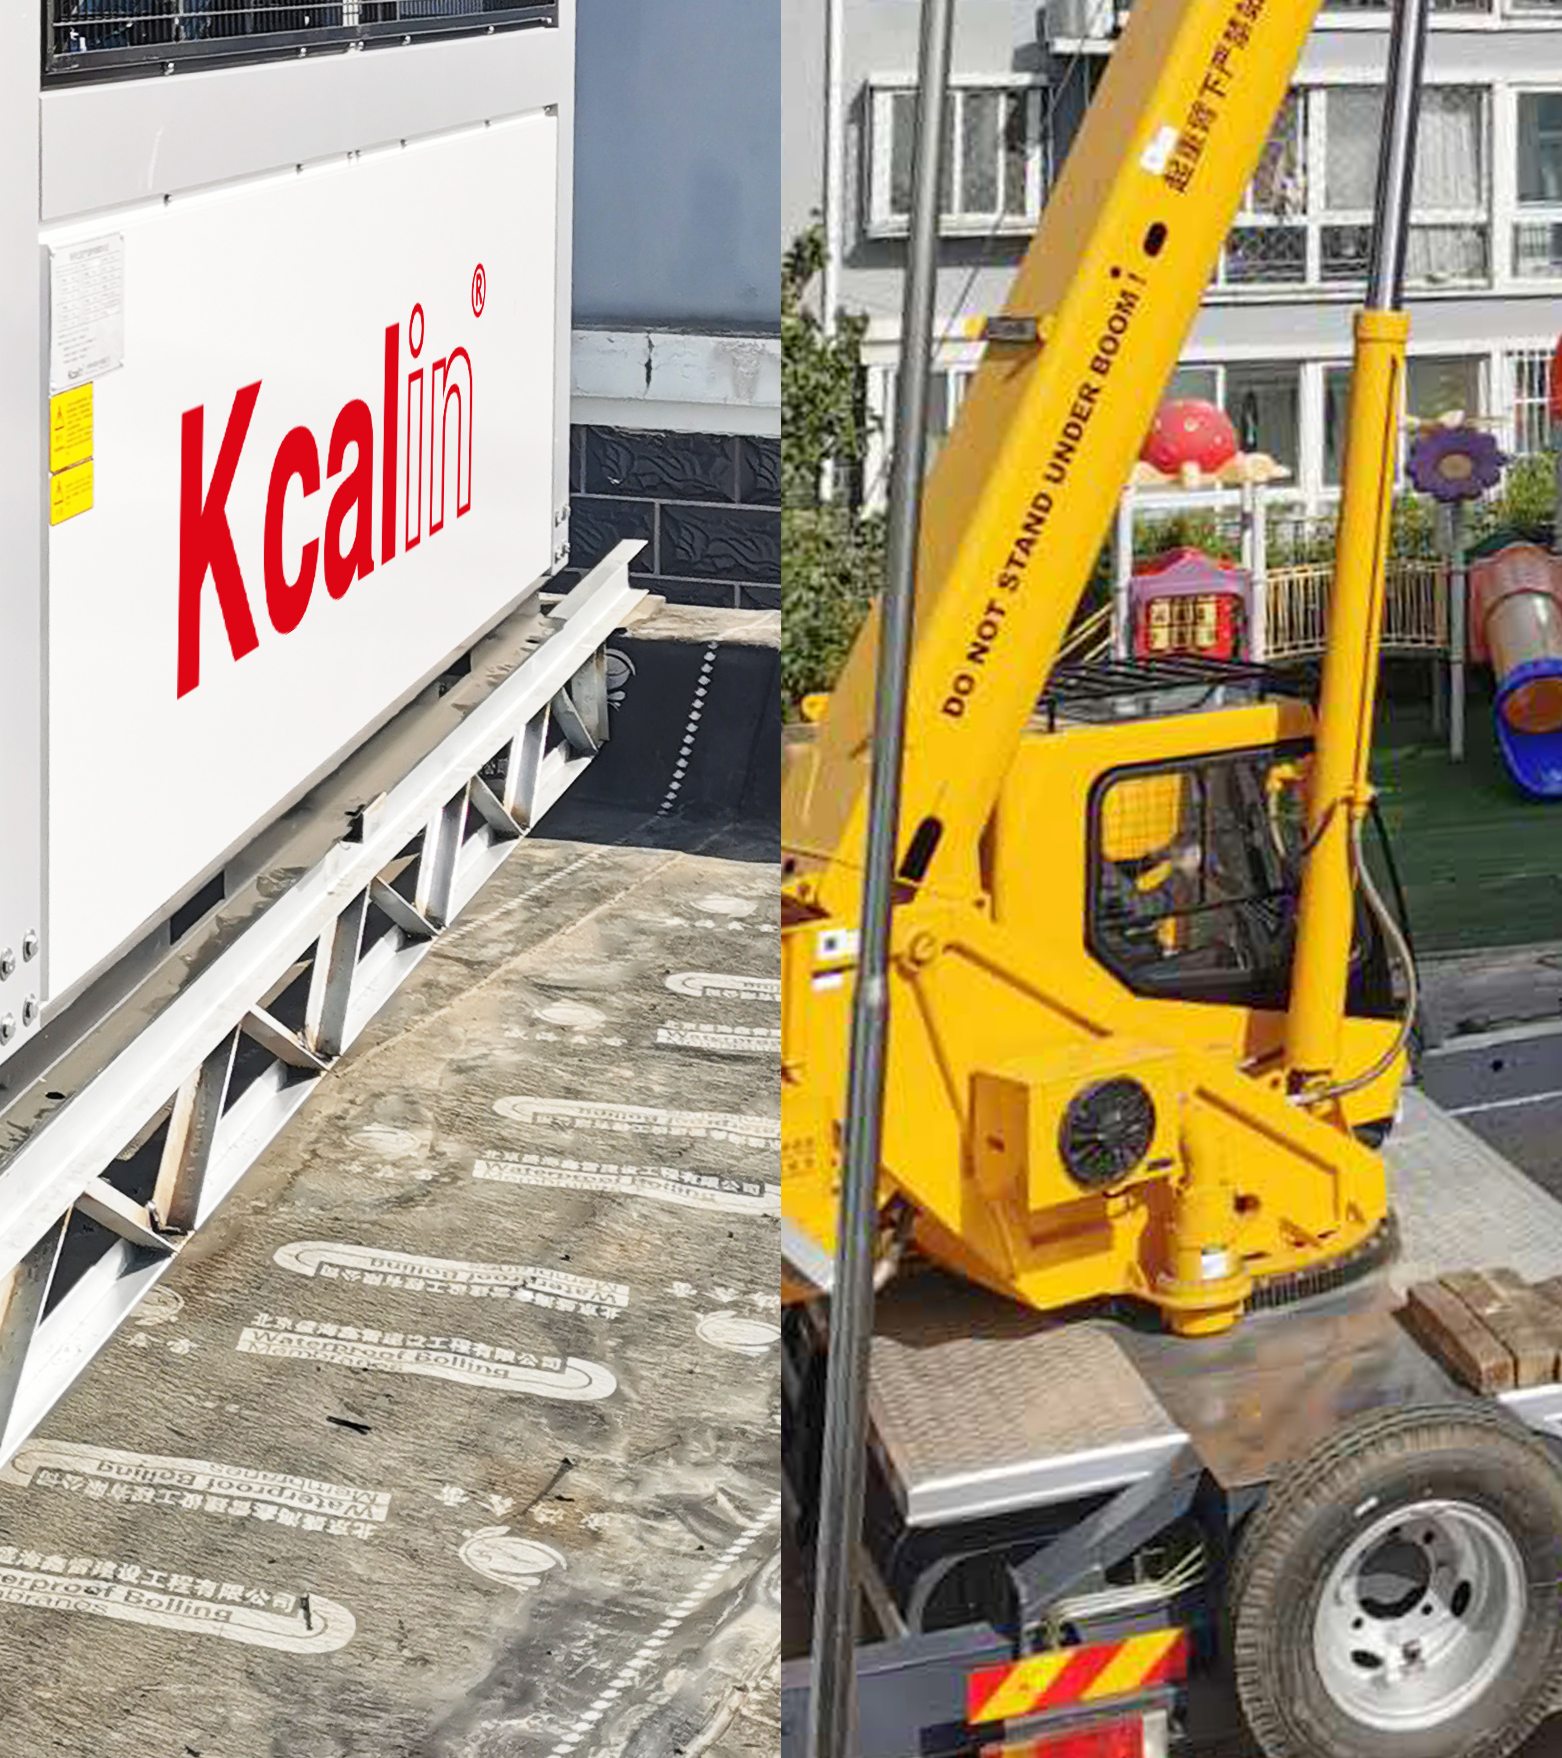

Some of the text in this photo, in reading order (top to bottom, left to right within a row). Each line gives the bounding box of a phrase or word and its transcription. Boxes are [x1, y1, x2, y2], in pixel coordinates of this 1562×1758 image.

[941, 672, 975, 719] DO
[966, 599, 1006, 666] NOT
[998, 490, 1054, 592] STAND
[1044, 380, 1101, 485] UNDER
